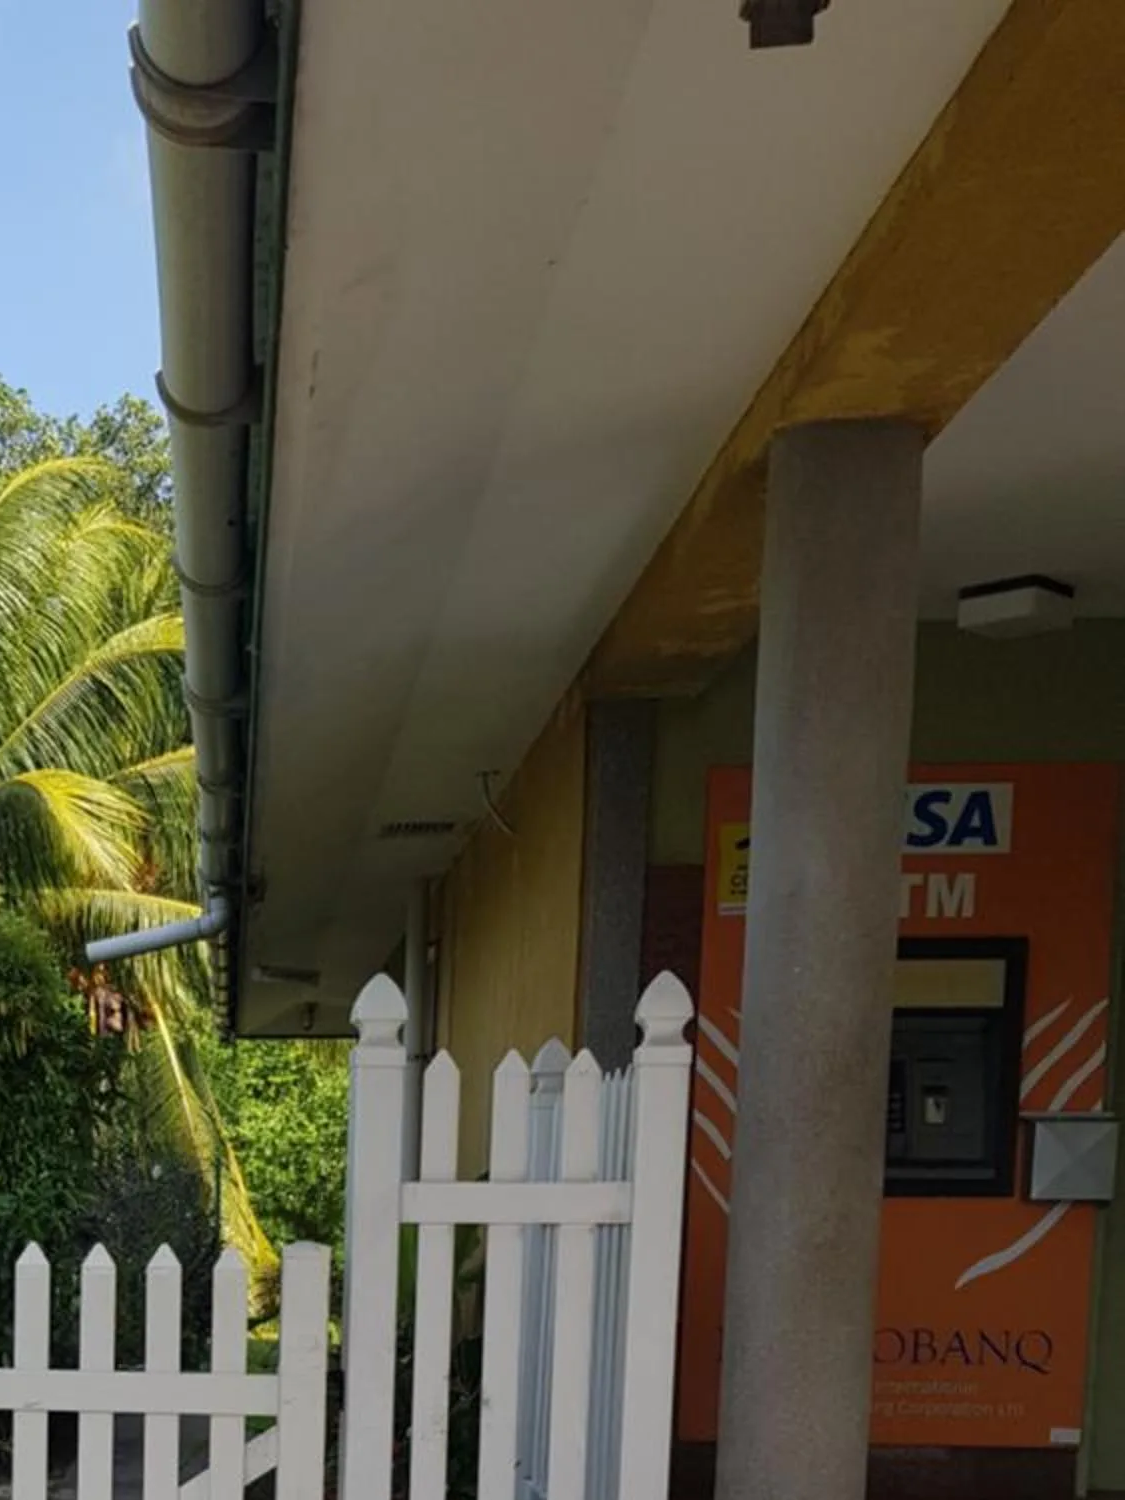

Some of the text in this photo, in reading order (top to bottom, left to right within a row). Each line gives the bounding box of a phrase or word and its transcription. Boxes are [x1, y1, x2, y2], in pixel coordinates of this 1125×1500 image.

[906, 789, 998, 847] SA
[899, 873, 976, 918] TM
[874, 1325, 1054, 1375] OBANQ
